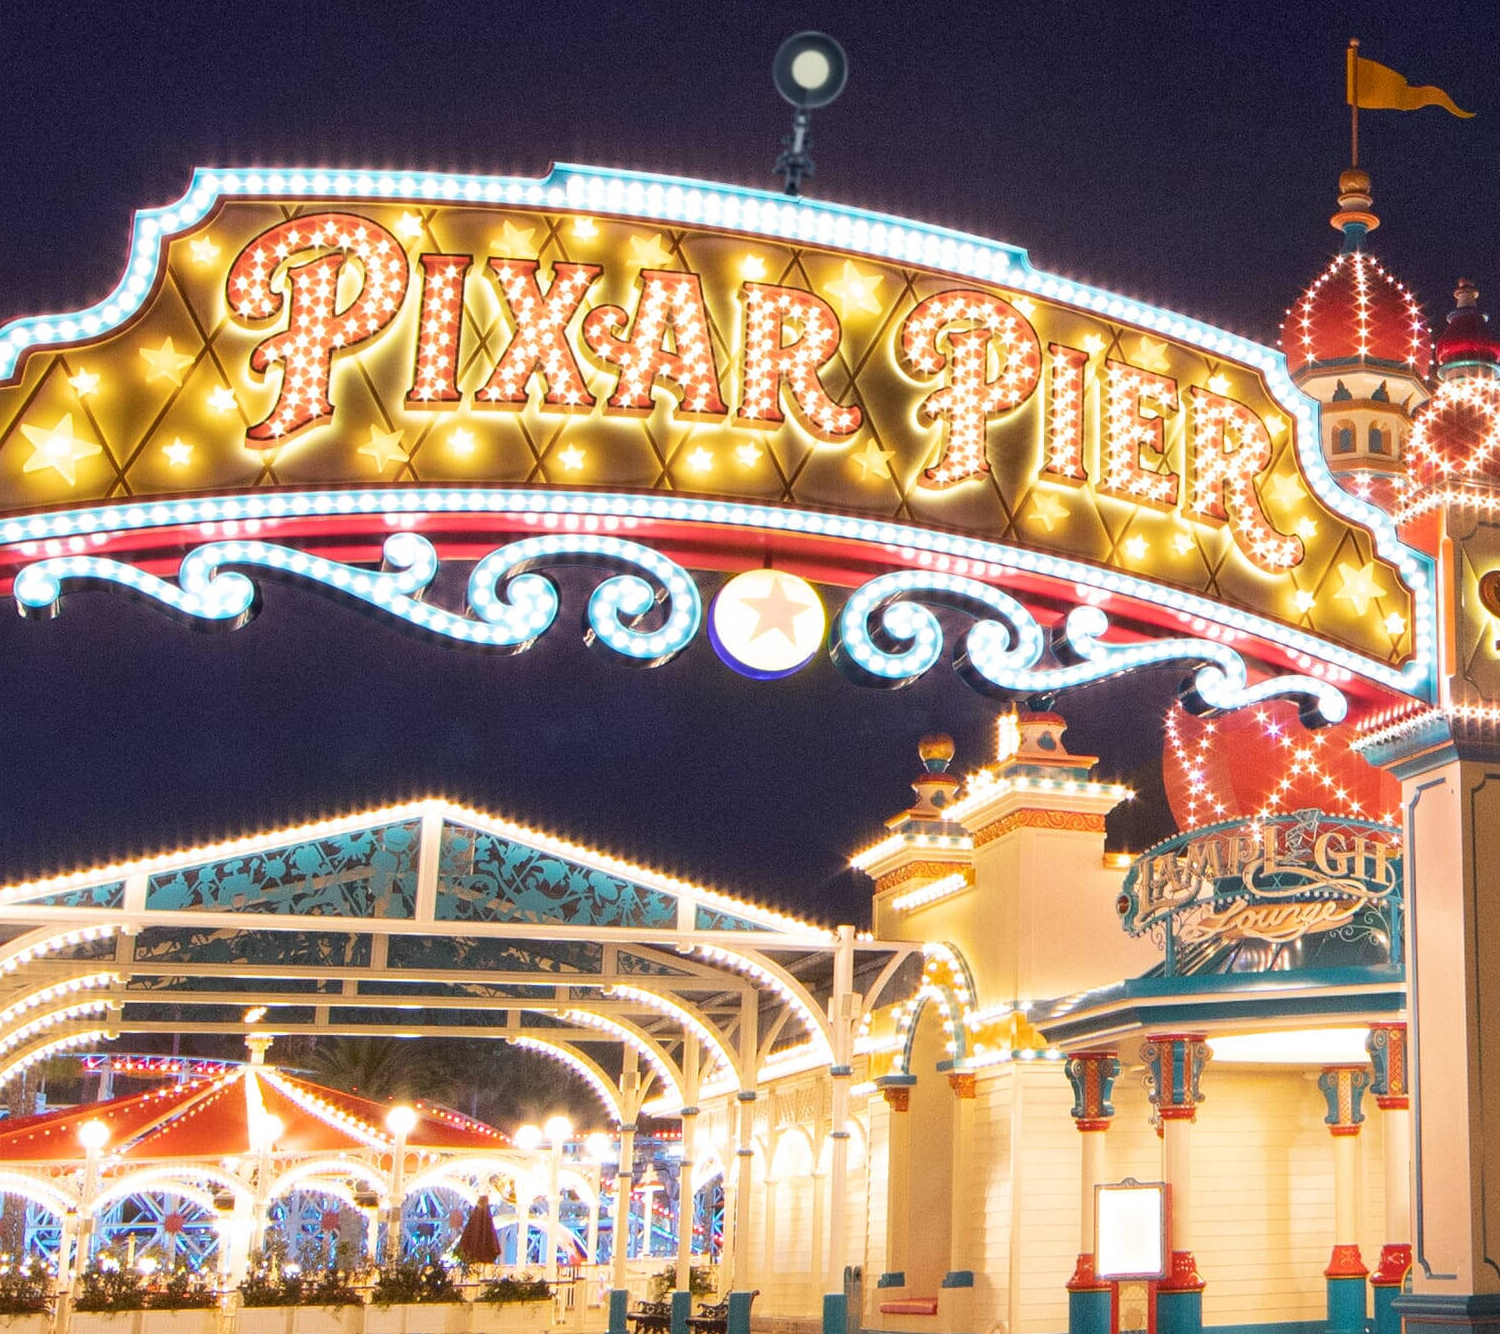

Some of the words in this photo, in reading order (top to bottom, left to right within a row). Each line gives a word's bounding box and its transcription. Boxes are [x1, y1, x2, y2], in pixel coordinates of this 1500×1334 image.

[225, 212, 864, 449] PIXAR
[900, 288, 1305, 569] PIER
[1184, 897, 1367, 943] Lounge
